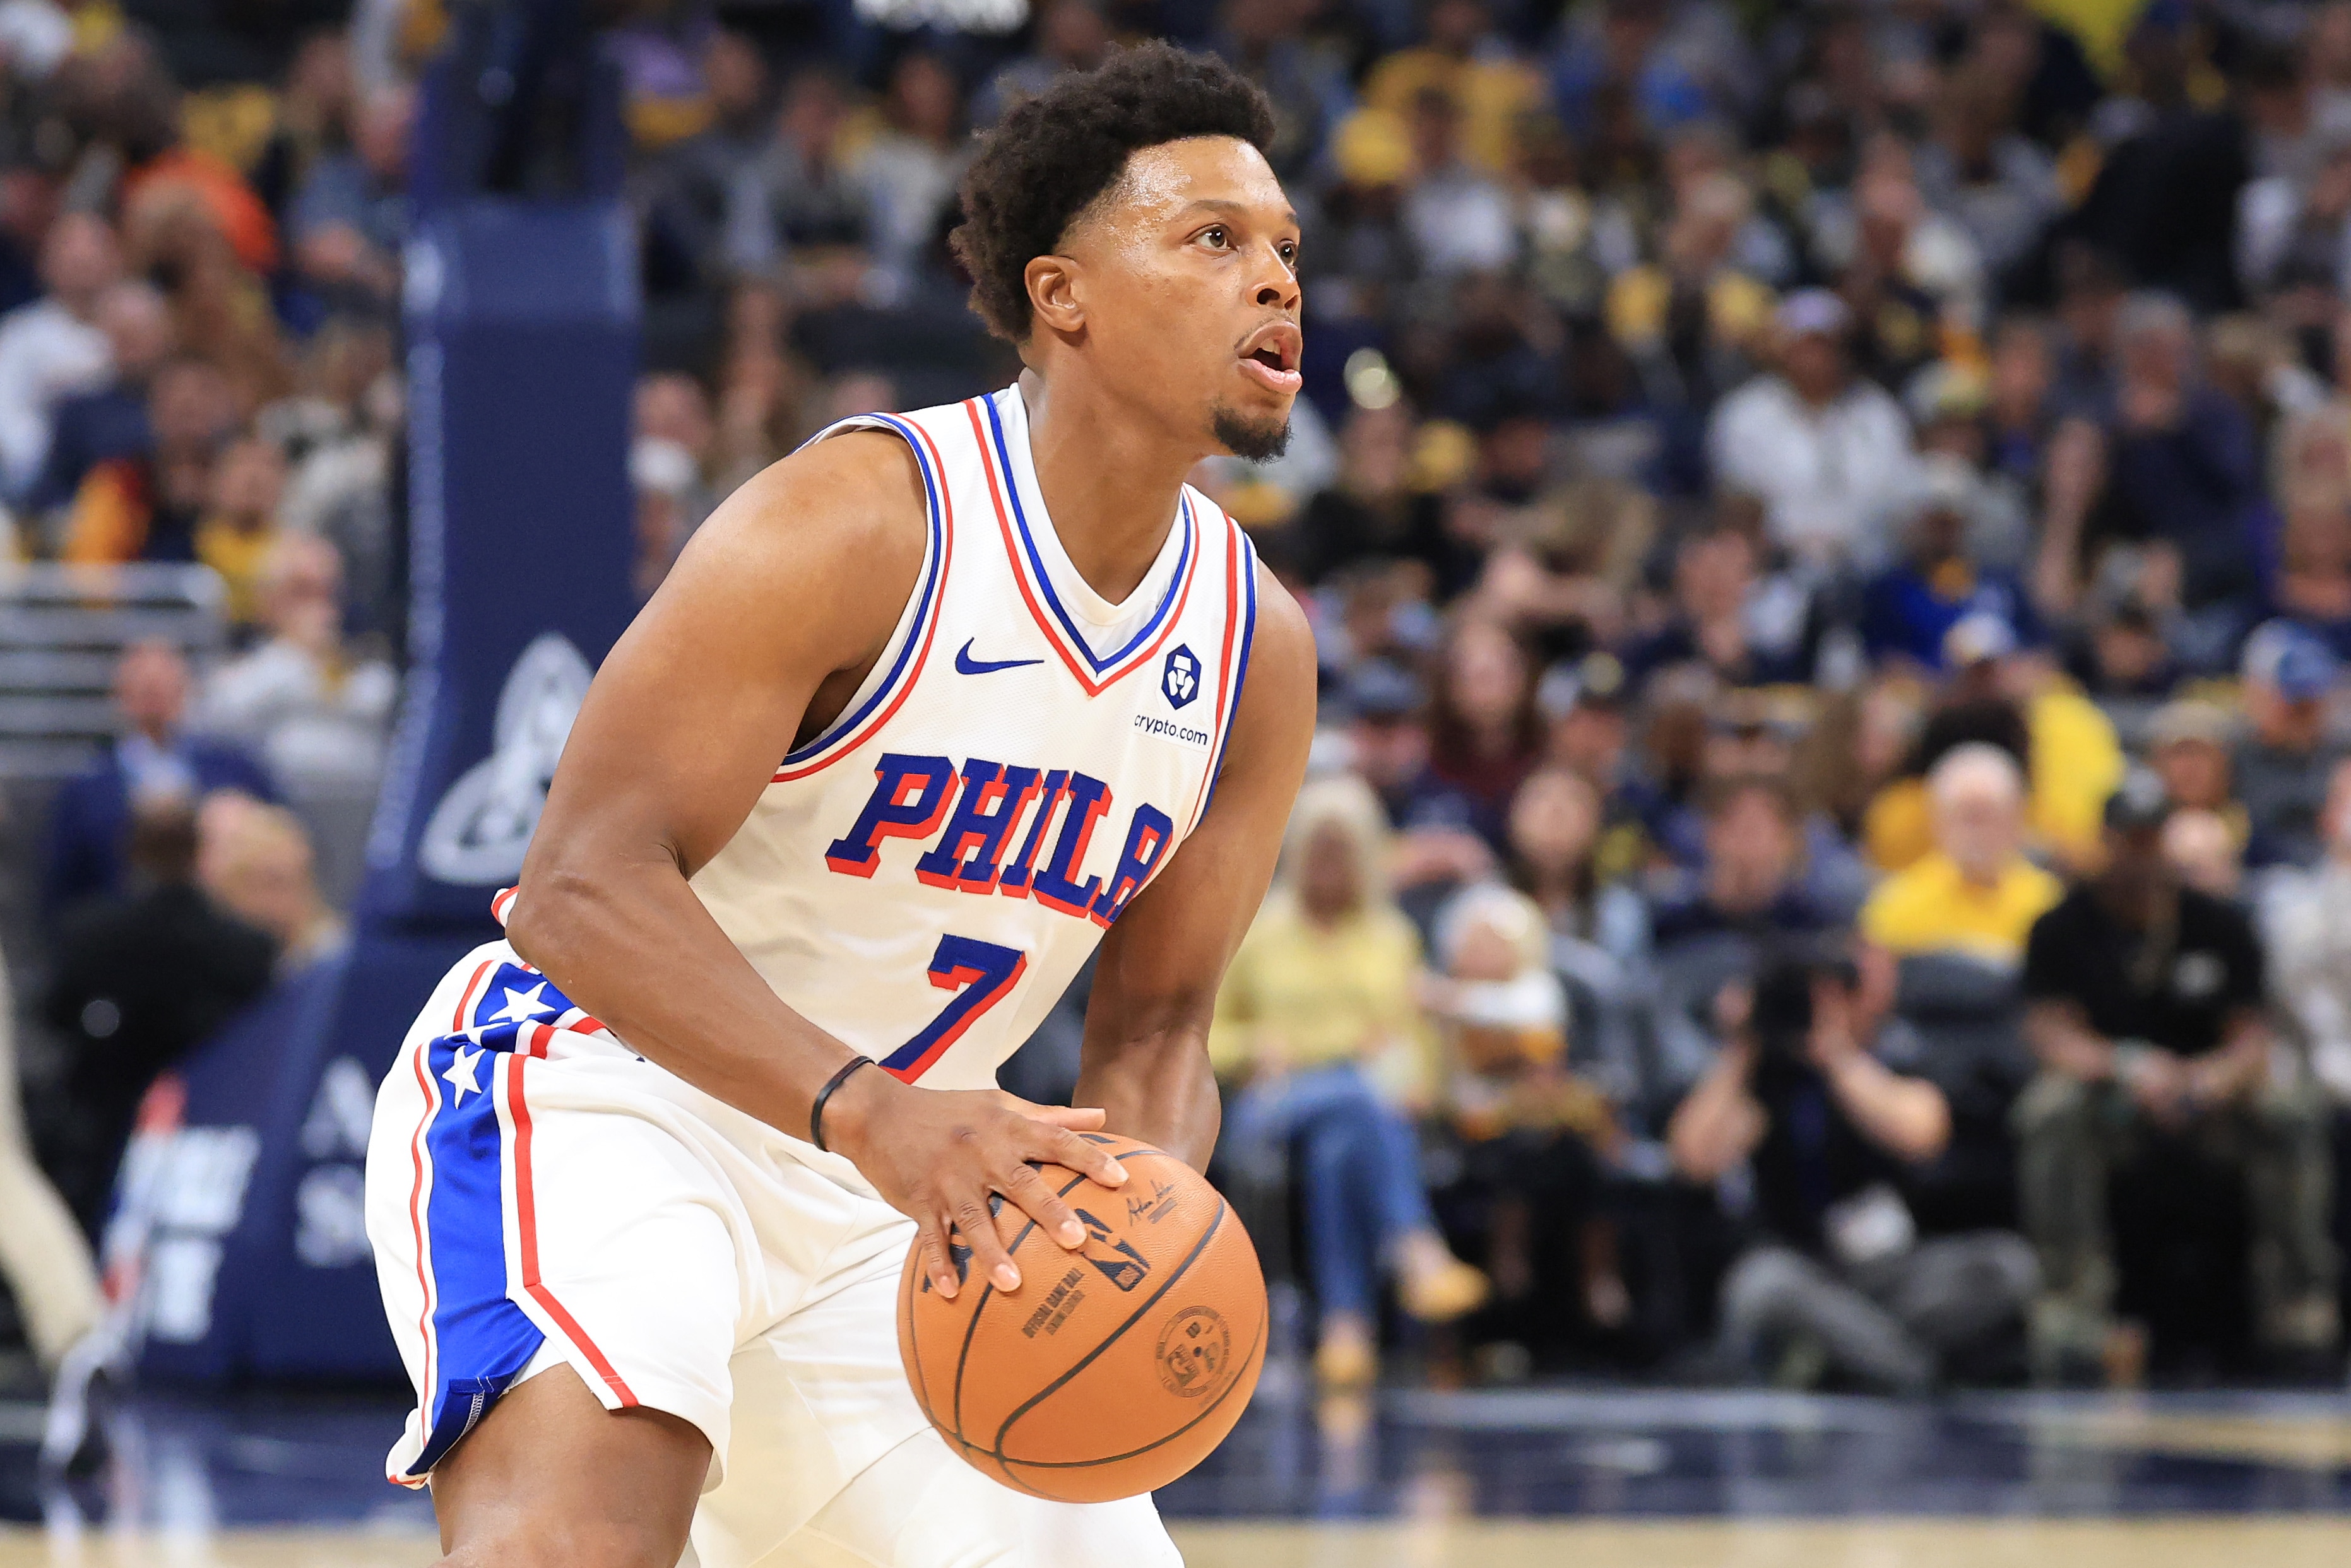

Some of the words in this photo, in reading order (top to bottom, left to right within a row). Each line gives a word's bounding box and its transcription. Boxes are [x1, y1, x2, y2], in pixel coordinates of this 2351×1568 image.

[1134, 714, 1208, 745] crypto.com
[824, 753, 1174, 930] PHILA
[877, 933, 1027, 1085] 7
